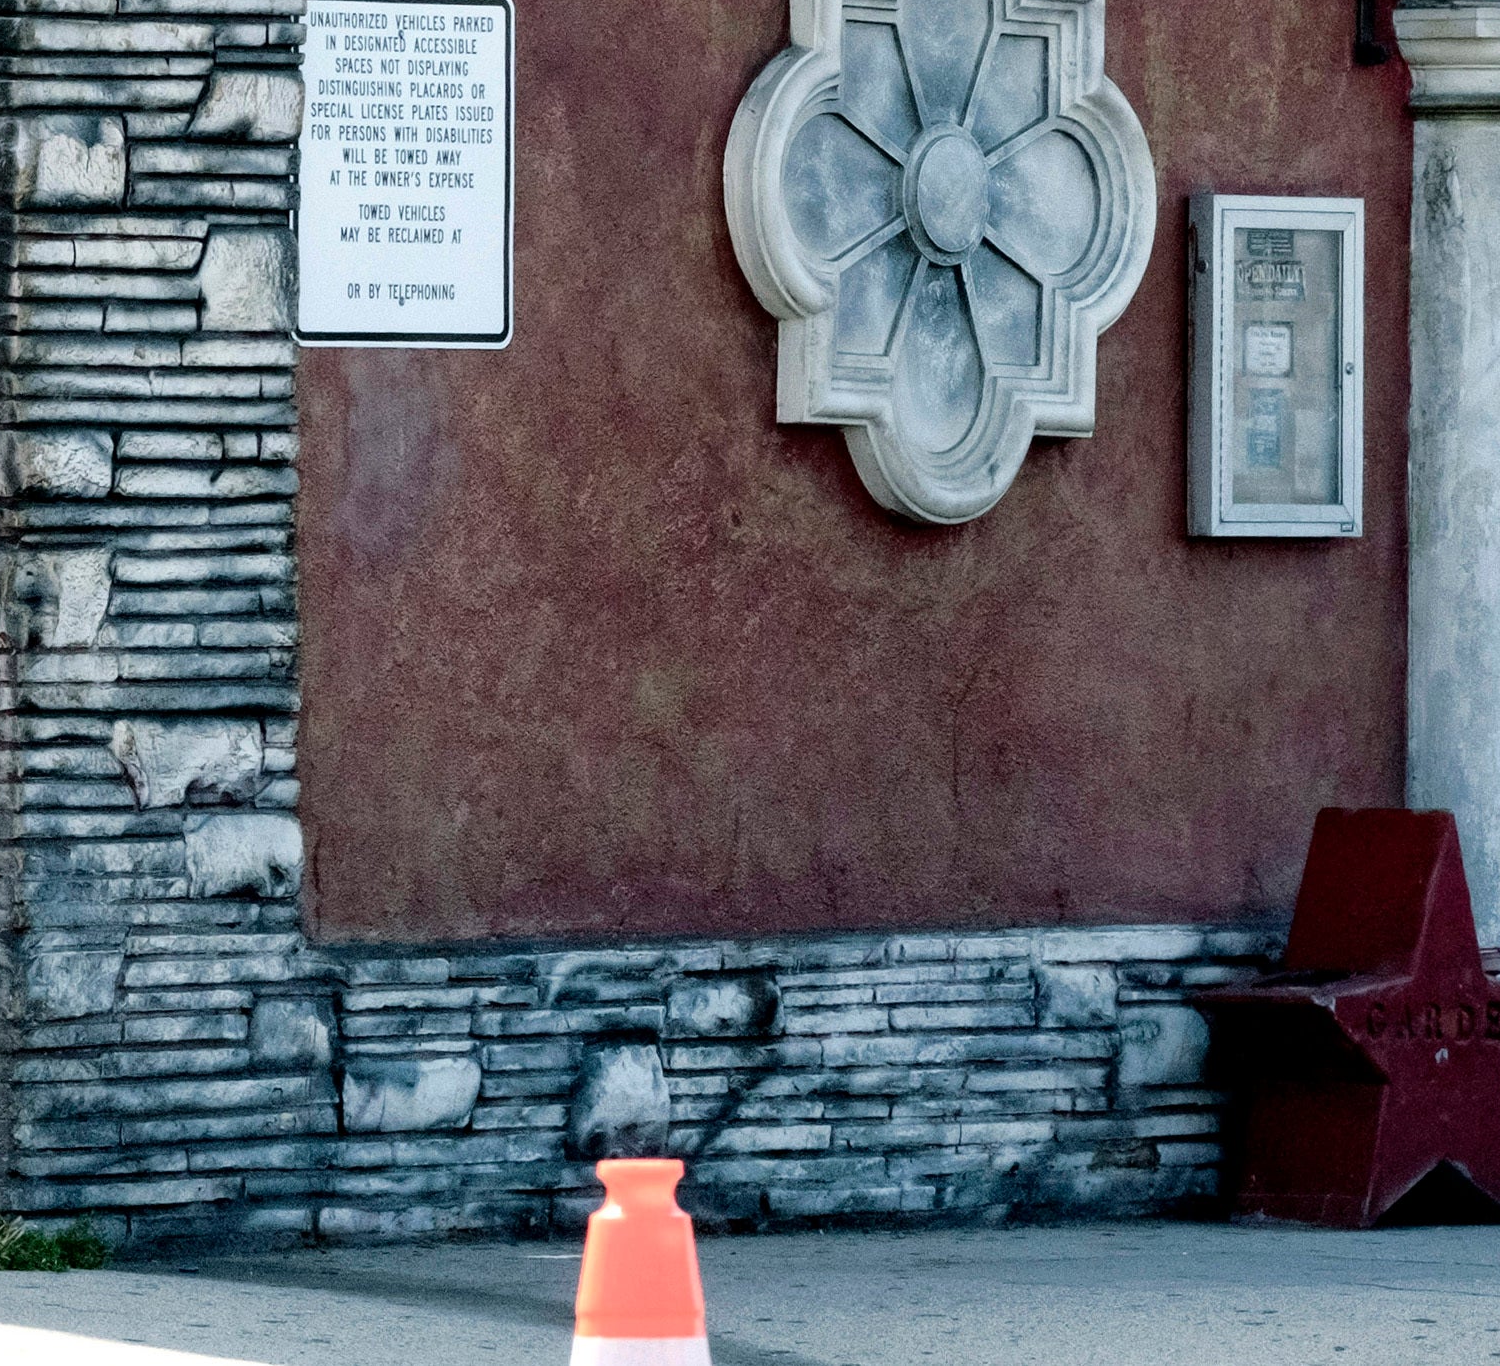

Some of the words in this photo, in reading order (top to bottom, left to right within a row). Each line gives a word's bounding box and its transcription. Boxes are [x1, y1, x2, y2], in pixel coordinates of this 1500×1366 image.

[310, 11, 388, 29] UNAUTHORIZED
[395, 14, 446, 32] VEHICLES
[453, 16, 494, 33] PARKED
[326, 35, 336, 50] IN
[344, 35, 406, 52] DESIGNATED
[414, 37, 478, 55] ACCESSIBLE
[335, 57, 373, 74] SPACES
[381, 59, 400, 75] NOT
[408, 60, 469, 77] DISPLAYING
[318, 79, 402, 98] DISTINGUISHING
[410, 82, 464, 99] PLACARDS
[471, 83, 486, 99] OR
[311, 102, 354, 118] SPECIAL
[361, 103, 404, 120] LICENSE
[412, 104, 448, 121] PLATES
[456, 106, 494, 122] ISSUED
[311, 124, 330, 141] FOR
[339, 125, 386, 142] PERSONS
[394, 126, 418, 143] WITH
[426, 127, 493, 144] DISABILITIES
[342, 148, 367, 164] WILL
[374, 148, 387, 164] BE
[395, 148, 428, 165] TOWED
[436, 150, 462, 166] AWAY
[329, 170, 340, 186] AT
[348, 170, 367, 186] THE
[374, 171, 421, 188] OWNER'S
[429, 172, 474, 189] EXPENSE
[359, 204, 390, 221] TOWED
[398, 205, 445, 222] VEHICLES
[340, 227, 360, 243] MAY
[368, 227, 381, 243] BE
[388, 228, 444, 244] RECLAIMED
[451, 229, 462, 244] AT
[347, 283, 361, 299] OR
[369, 283, 381, 299] BY
[388, 284, 455, 301] TELEPHONING
